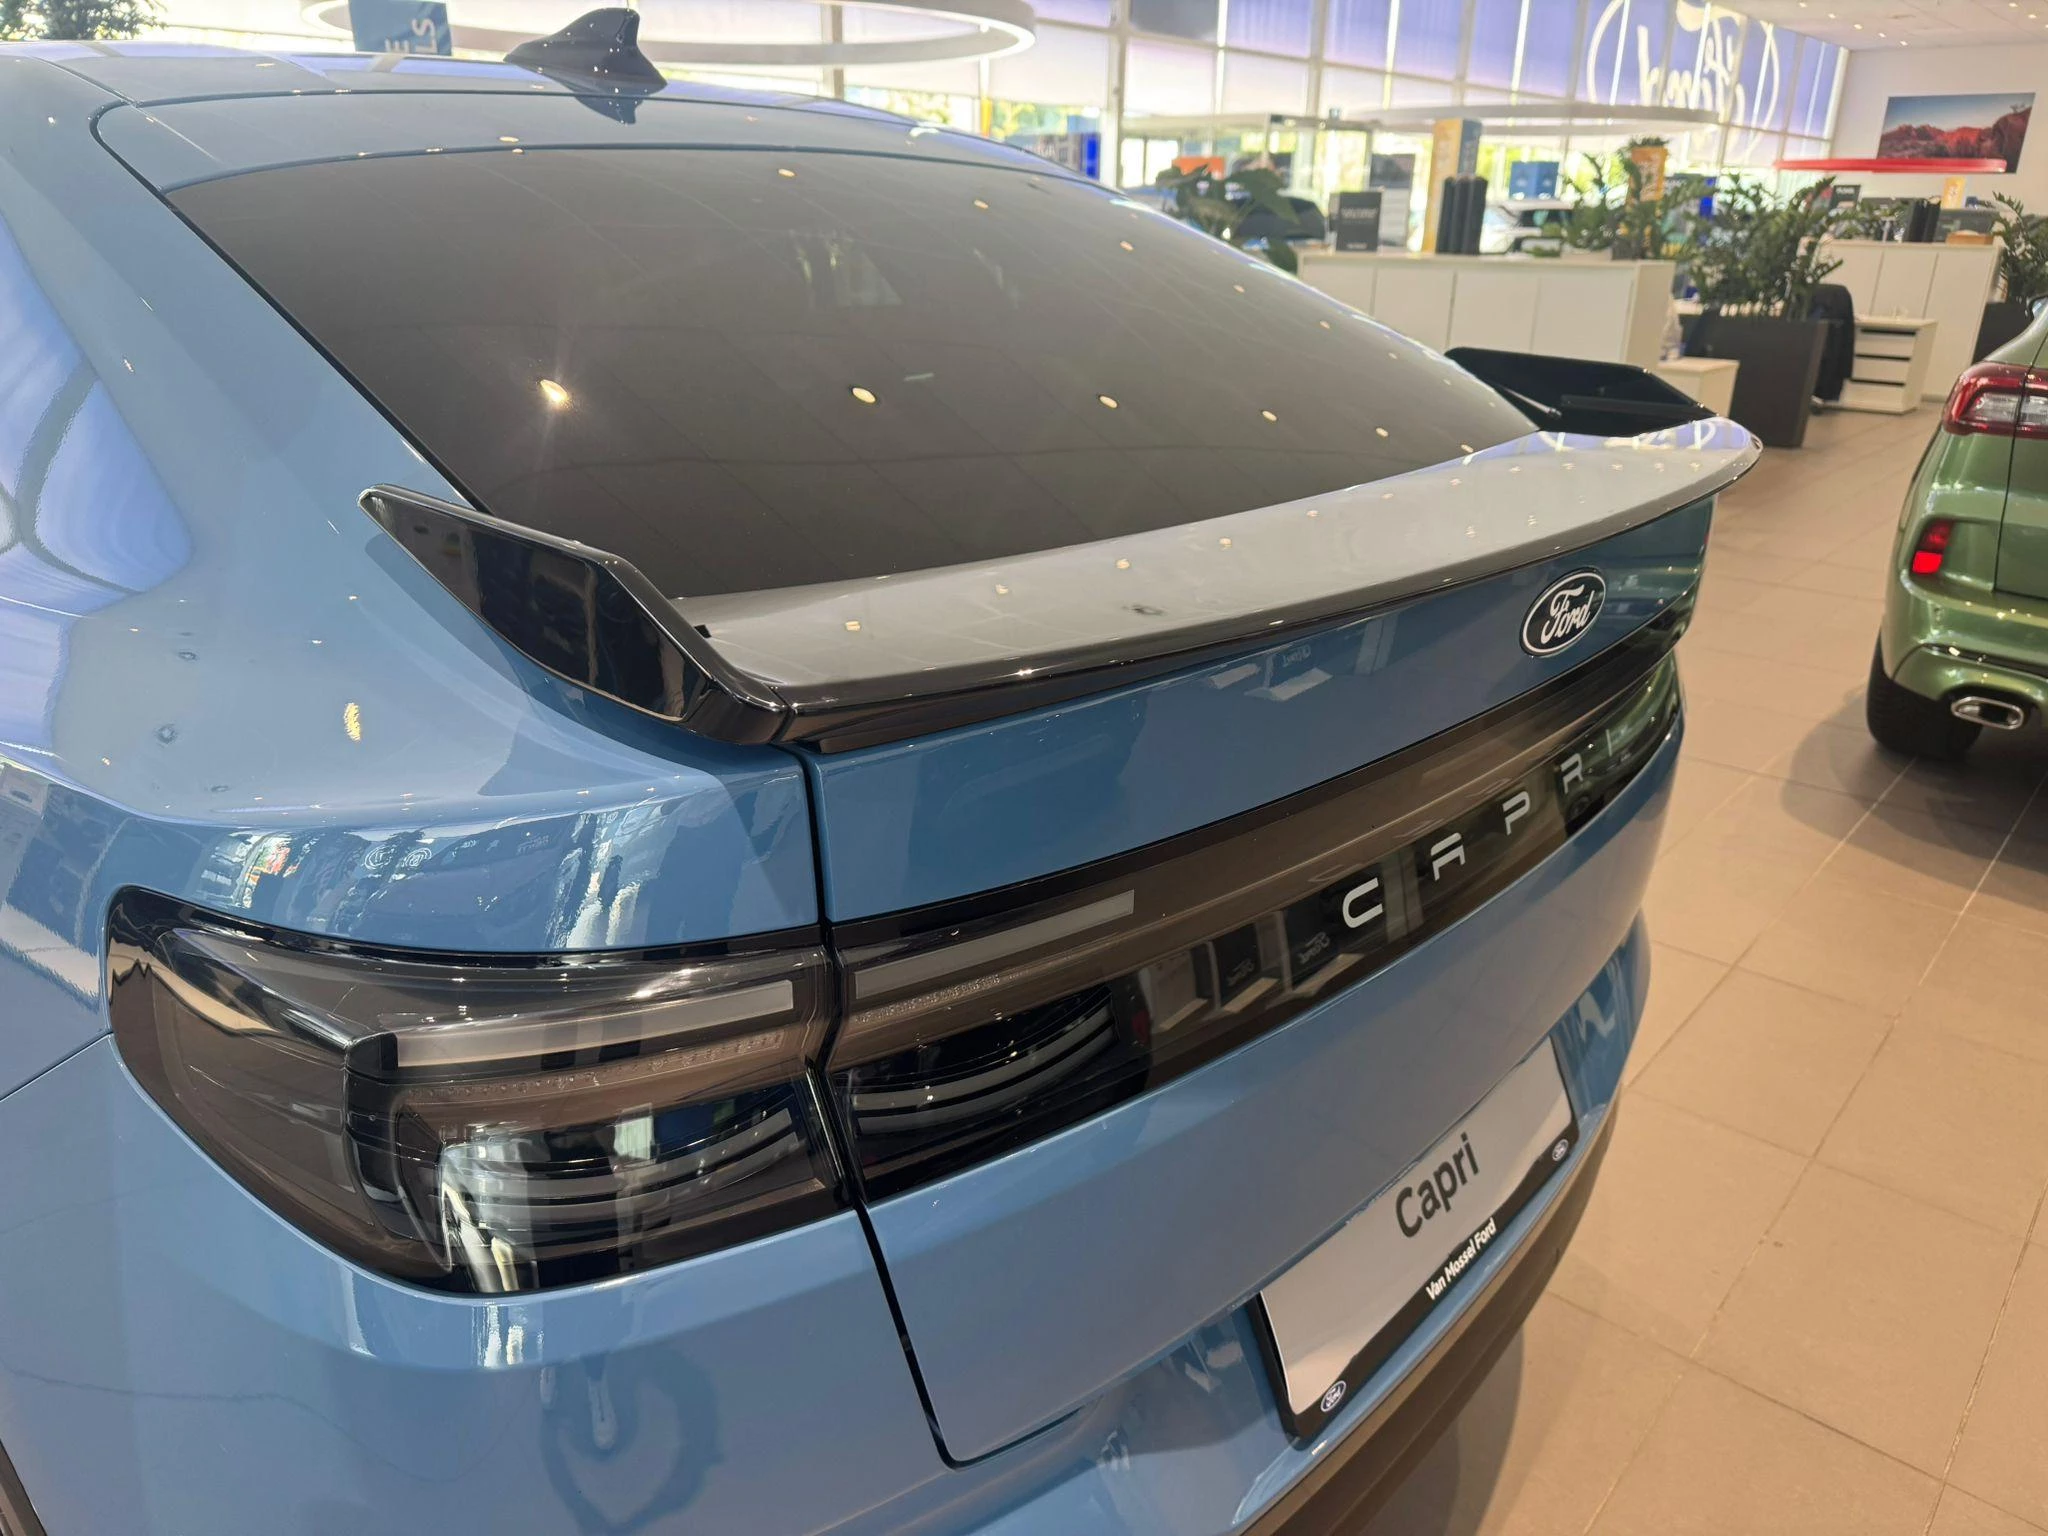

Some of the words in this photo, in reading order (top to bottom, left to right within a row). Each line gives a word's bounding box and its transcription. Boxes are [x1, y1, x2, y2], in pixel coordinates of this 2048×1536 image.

[1540, 584, 1596, 645] Ford
[1395, 1131, 1480, 1238] Capri
[1425, 1276, 1447, 1301] Van
[1444, 1238, 1477, 1282] Mossel
[1473, 1216, 1497, 1250] Ford
